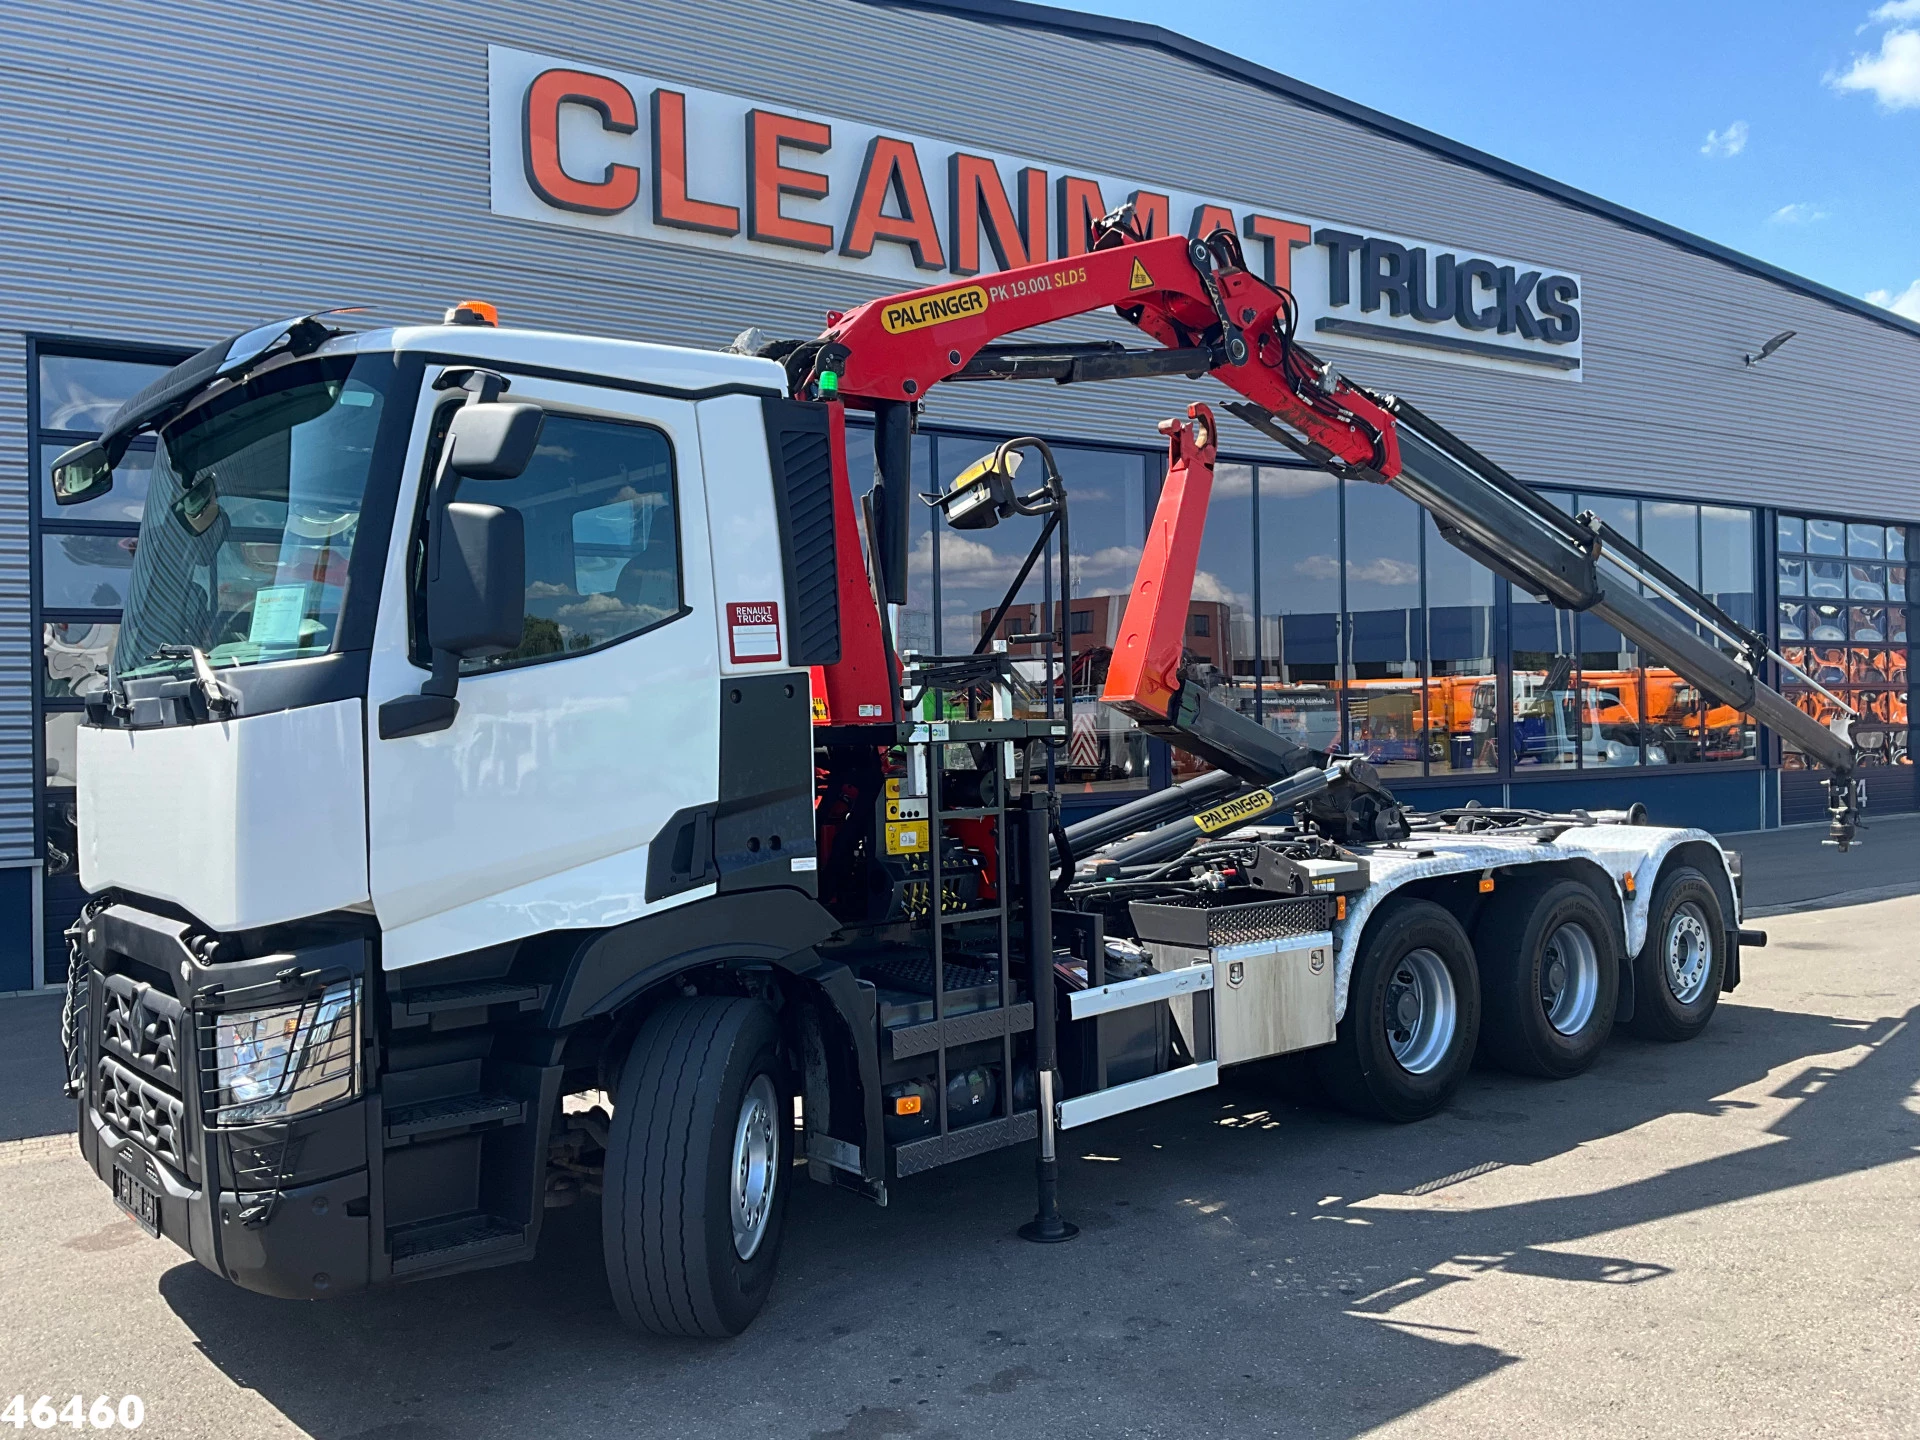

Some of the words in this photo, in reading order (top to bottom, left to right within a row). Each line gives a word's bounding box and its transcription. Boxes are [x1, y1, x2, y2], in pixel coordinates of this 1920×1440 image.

[989, 287, 1009, 303] PK
[1011, 275, 1053, 298] 19.001
[1314, 228, 1581, 345] TRUCKS
[887, 290, 983, 329] PALFINGER
[736, 606, 772, 616] RENAULT
[737, 615, 773, 624] TRUCKS
[1856, 779, 1868, 808] 4
[1200, 792, 1270, 829] PALFINGER
